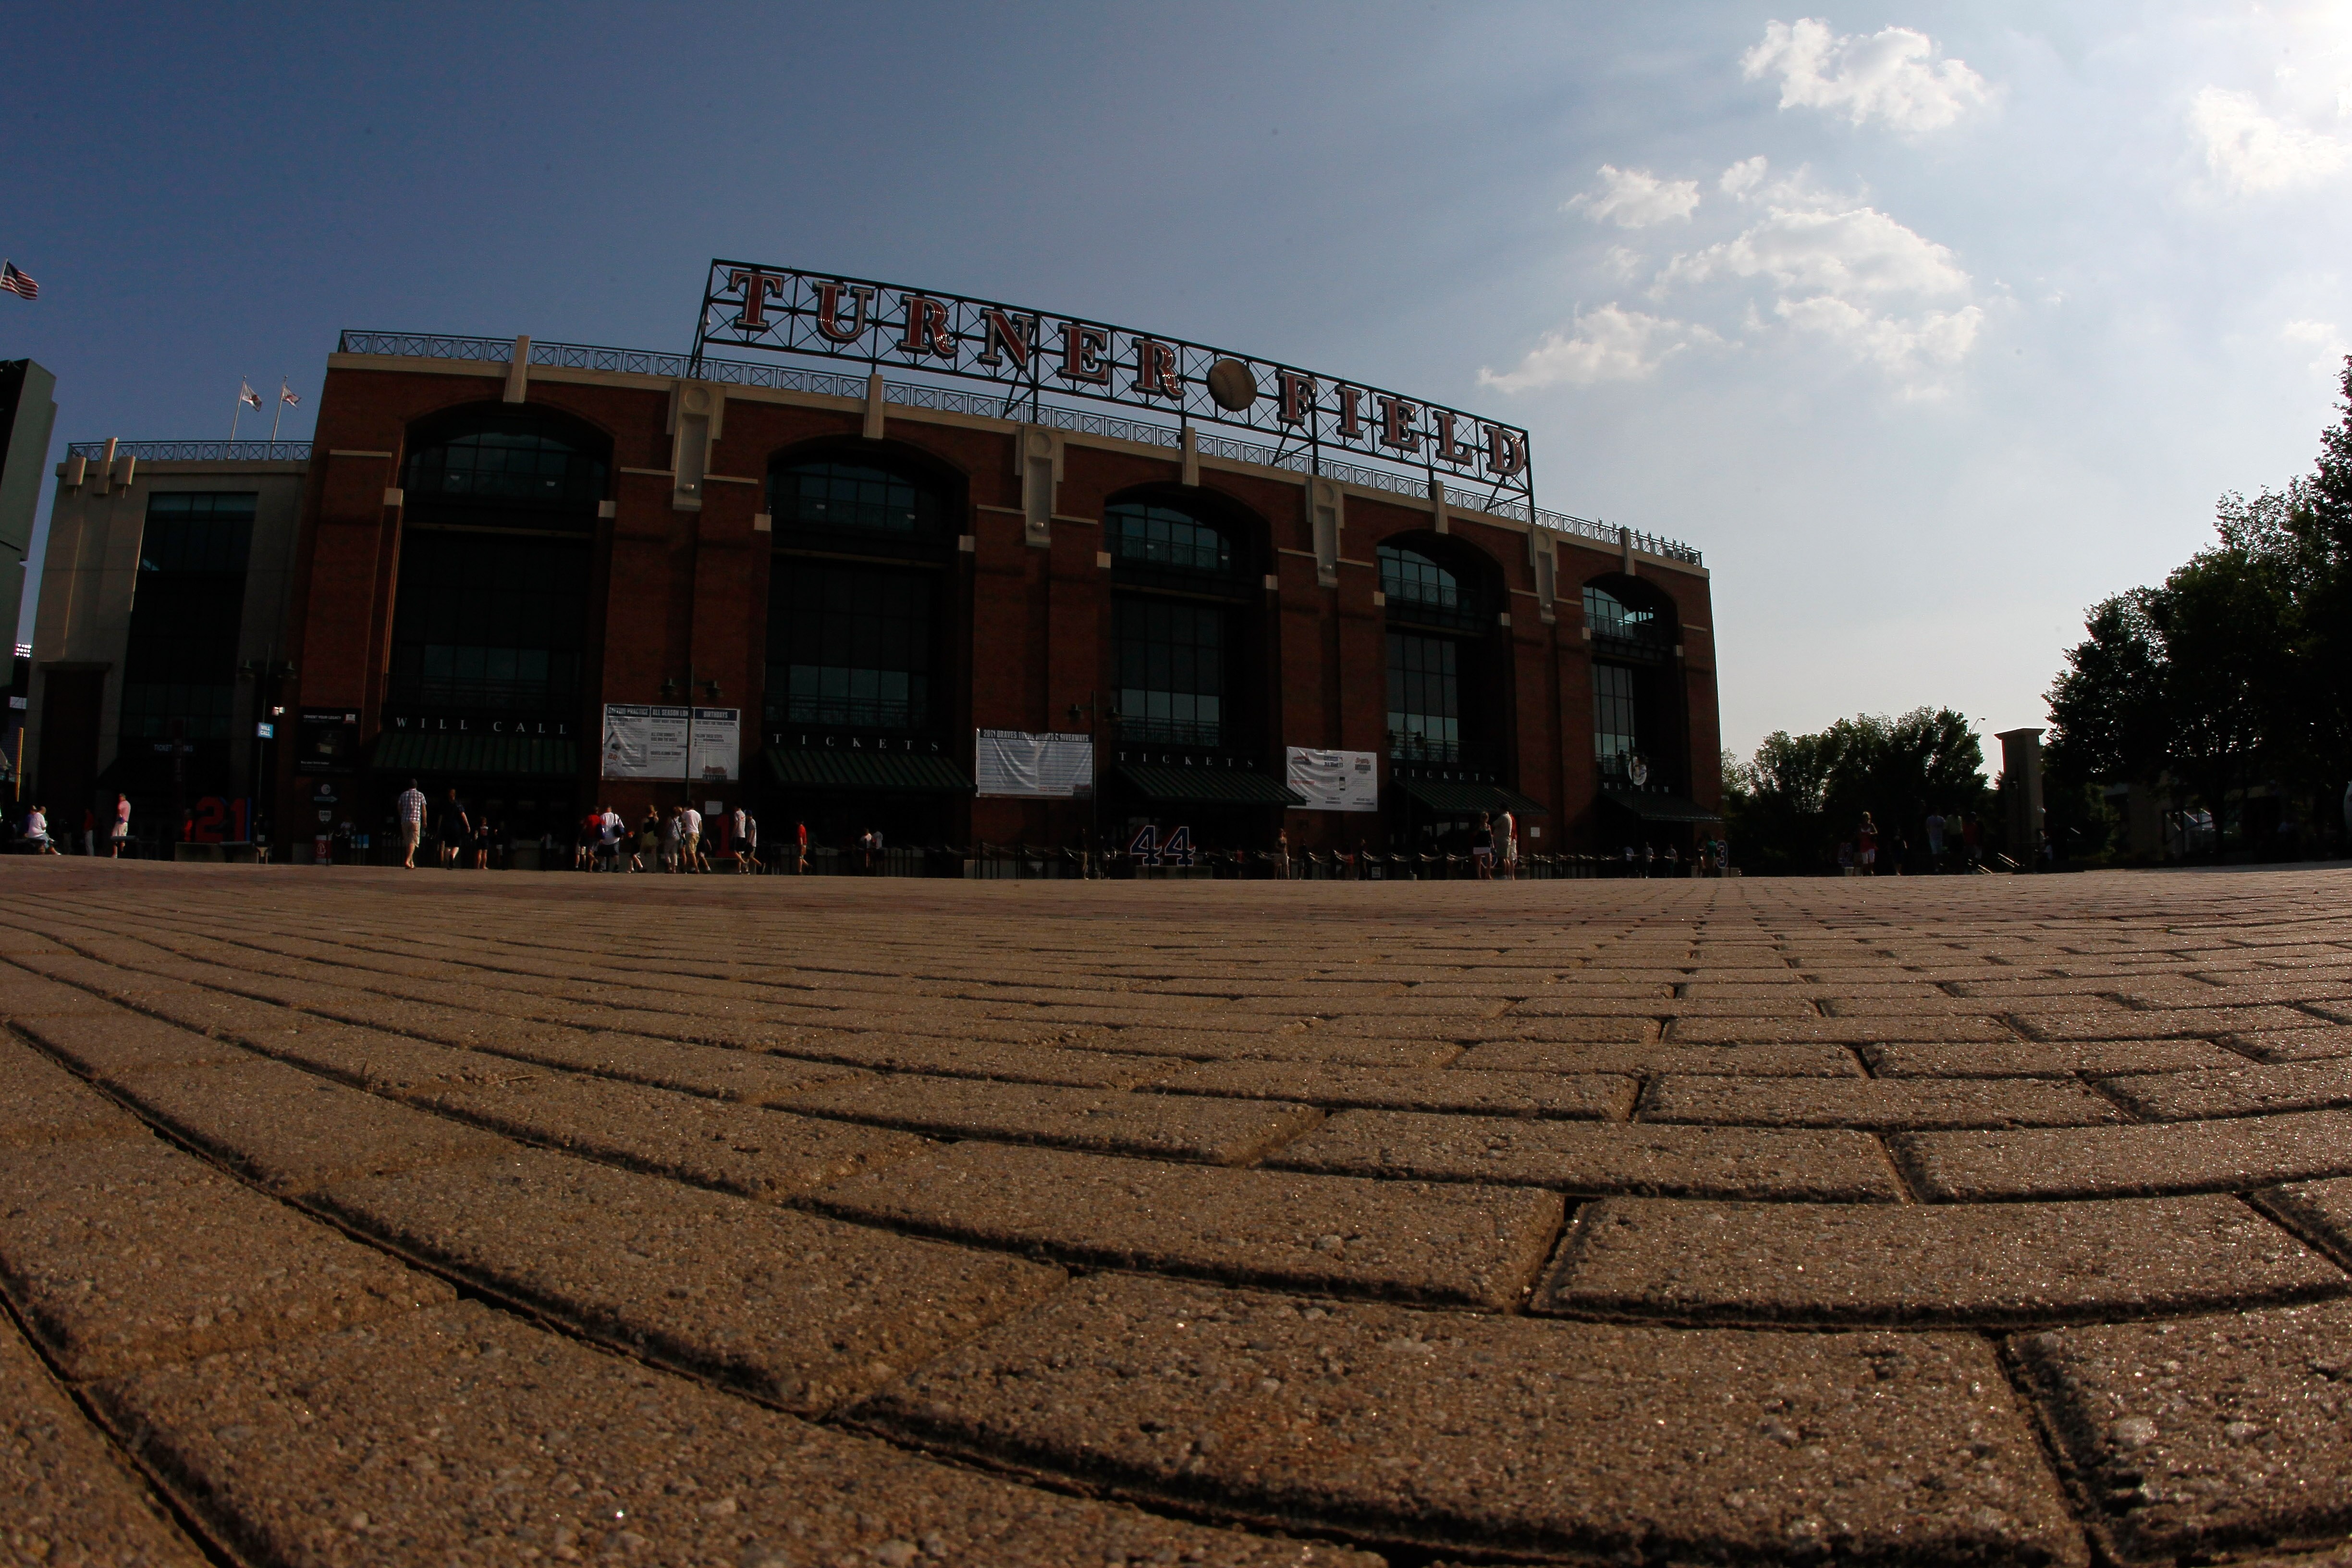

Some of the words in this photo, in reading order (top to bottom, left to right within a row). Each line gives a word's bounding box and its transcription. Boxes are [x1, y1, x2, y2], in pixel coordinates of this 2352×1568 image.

[727, 268, 1187, 400] TURNER
[1275, 368, 1526, 477] FIELD
[396, 716, 469, 730] WILL
[492, 721, 568, 735] CALL
[772, 733, 940, 752] TICKETS
[997, 730, 1017, 739] BRAVES
[1060, 734, 1089, 742] GIVEAWAYS
[1118, 751, 1254, 769] TICKETS
[1392, 767, 1495, 783] TICKETS
[1603, 782, 1669, 793] MUSEUM
[195, 795, 251, 843] 21
[1130, 824, 1197, 867] 44
[1715, 840, 1728, 869] 3
